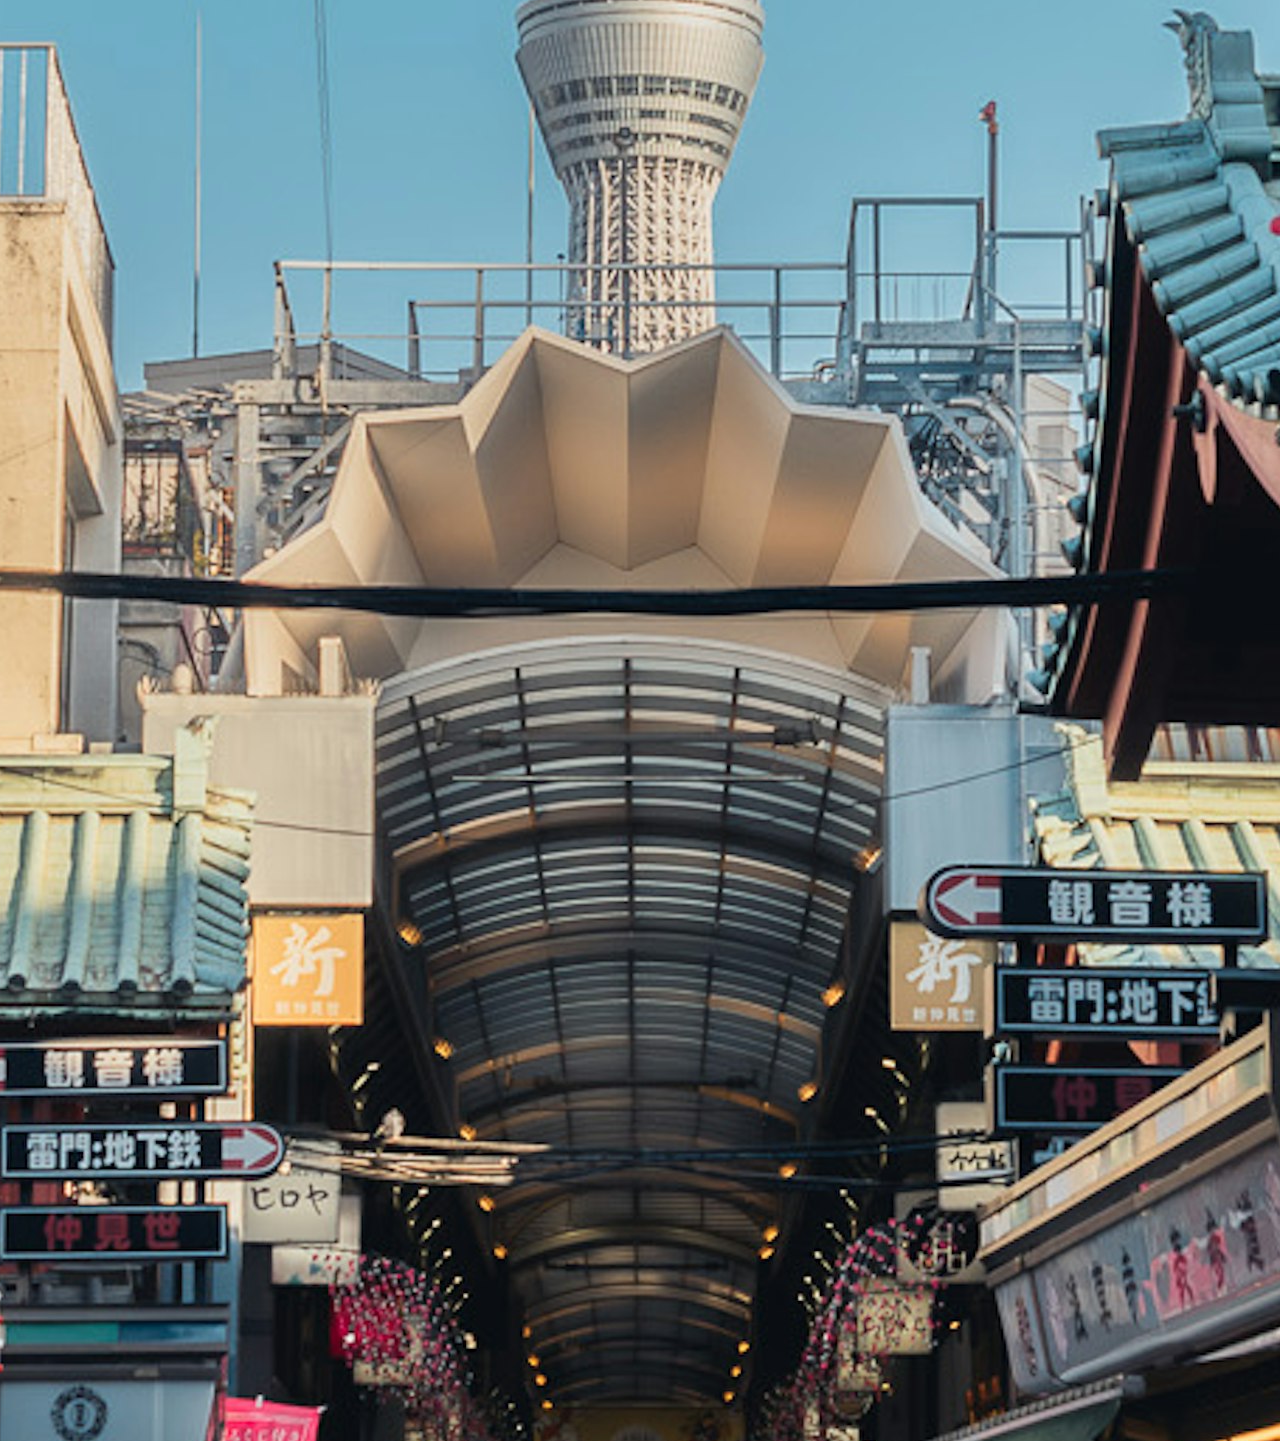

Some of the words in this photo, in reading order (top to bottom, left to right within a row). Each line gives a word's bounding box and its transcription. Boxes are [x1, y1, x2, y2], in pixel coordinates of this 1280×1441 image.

[1047, 879, 1214, 927] 観音様
[269, 922, 348, 996] 新
[906, 930, 982, 1004] 新
[42, 1048, 185, 1088] 観音様
[250, 1183, 329, 1216] ヒロヤ
[43, 1212, 182, 1252] 仲見世
